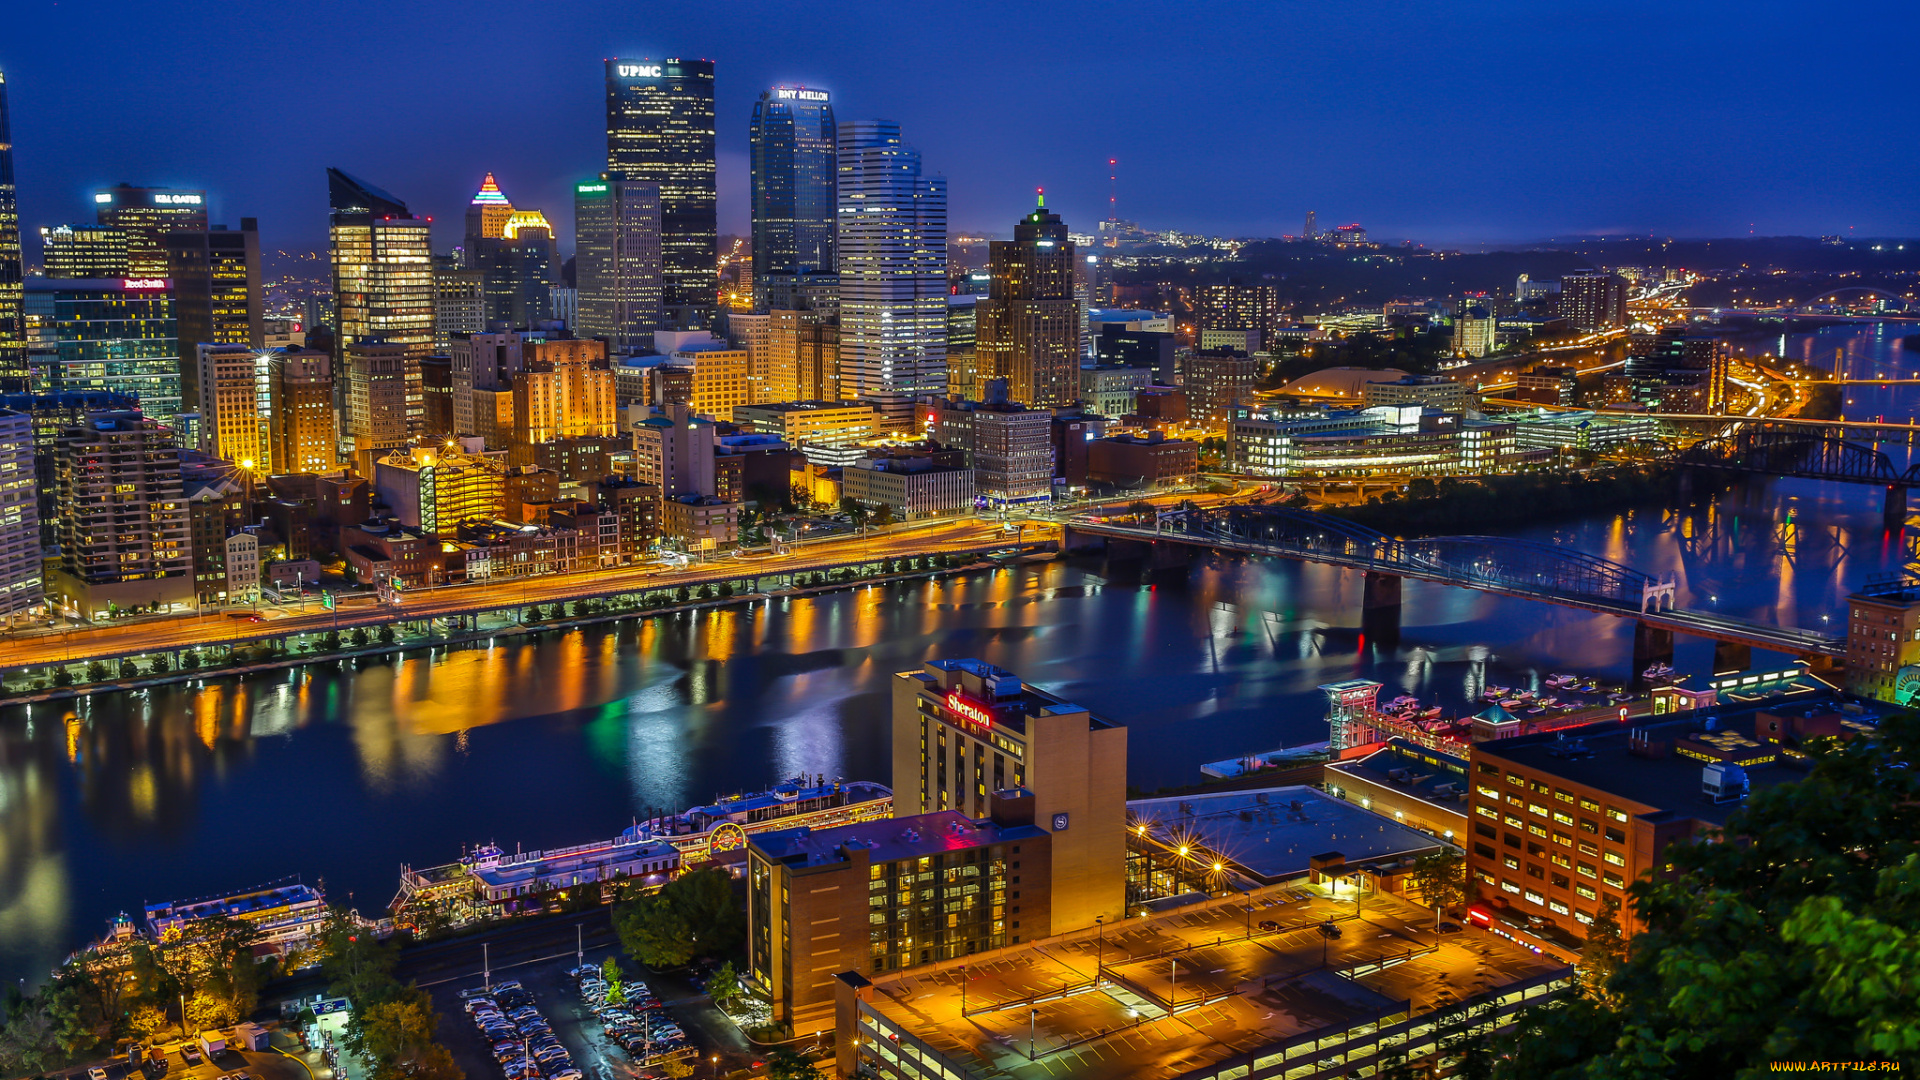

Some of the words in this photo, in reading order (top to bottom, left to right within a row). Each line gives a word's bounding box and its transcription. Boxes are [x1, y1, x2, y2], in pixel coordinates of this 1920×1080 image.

[618, 65, 662, 77] UPMC
[778, 90, 798, 99] BNY
[798, 91, 828, 102] MELLON
[172, 195, 201, 204] GATES
[124, 280, 143, 288] Reed
[143, 279, 165, 288] Smith
[1257, 413, 1269, 421] PNC
[948, 694, 990, 727] Sheraton
